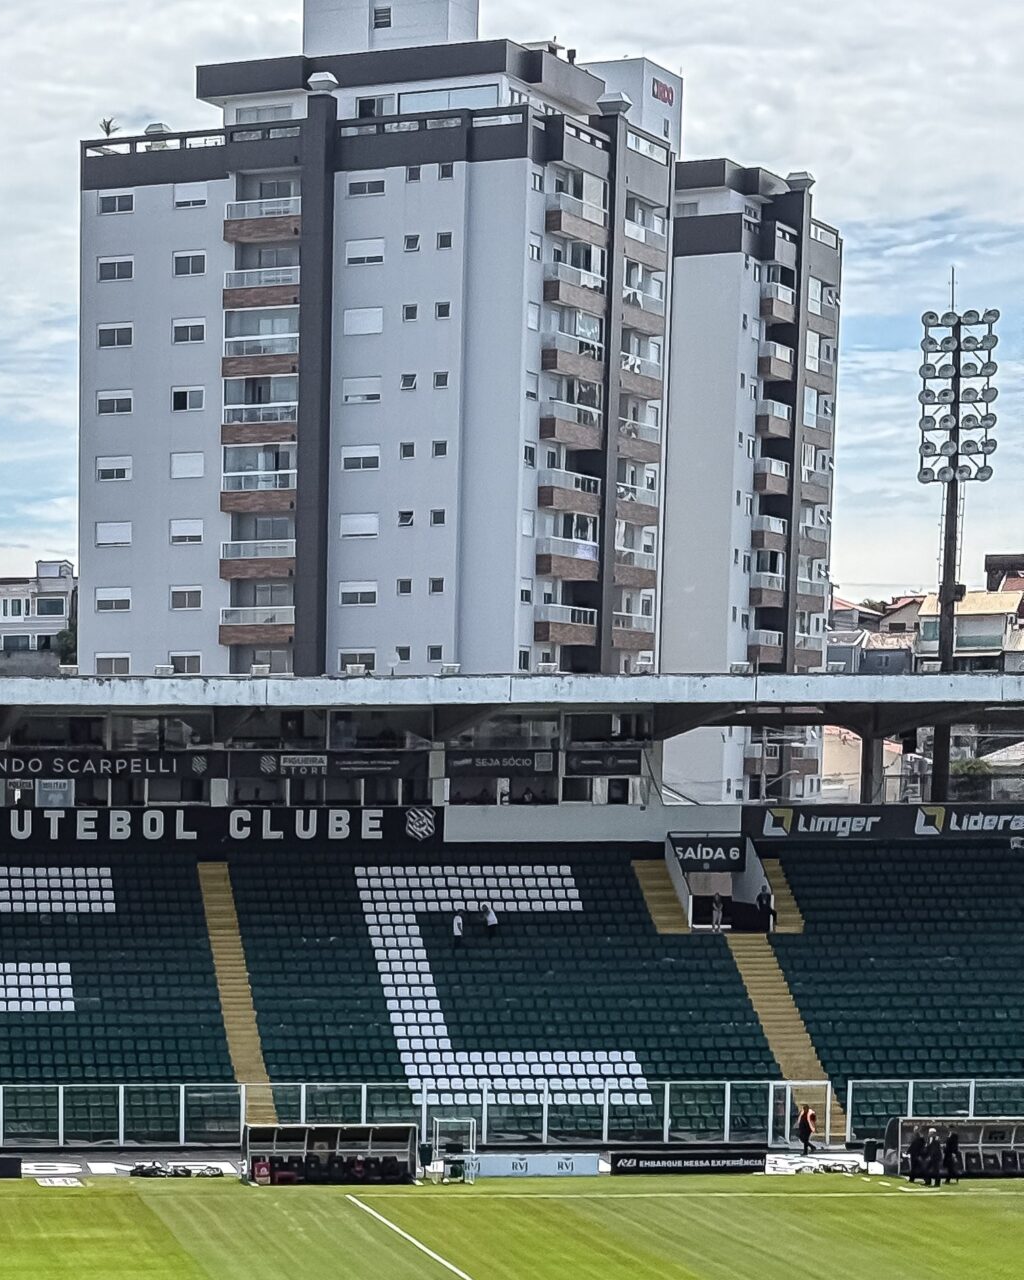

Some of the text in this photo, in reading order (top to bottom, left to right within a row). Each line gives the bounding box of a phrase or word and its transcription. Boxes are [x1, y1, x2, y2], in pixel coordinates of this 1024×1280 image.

[52, 758, 176, 774] SCARPELLI
[475, 758, 500, 767] SEJA
[502, 756, 532, 767] SÓCIO
[280, 766, 327, 775] STORE
[229, 809, 384, 840] CLUBE
[797, 813, 881, 837] Limger
[675, 843, 741, 861] SAÍDA 6
[512, 1161, 529, 1173] RVJ
[557, 1161, 574, 1172] RVJ
